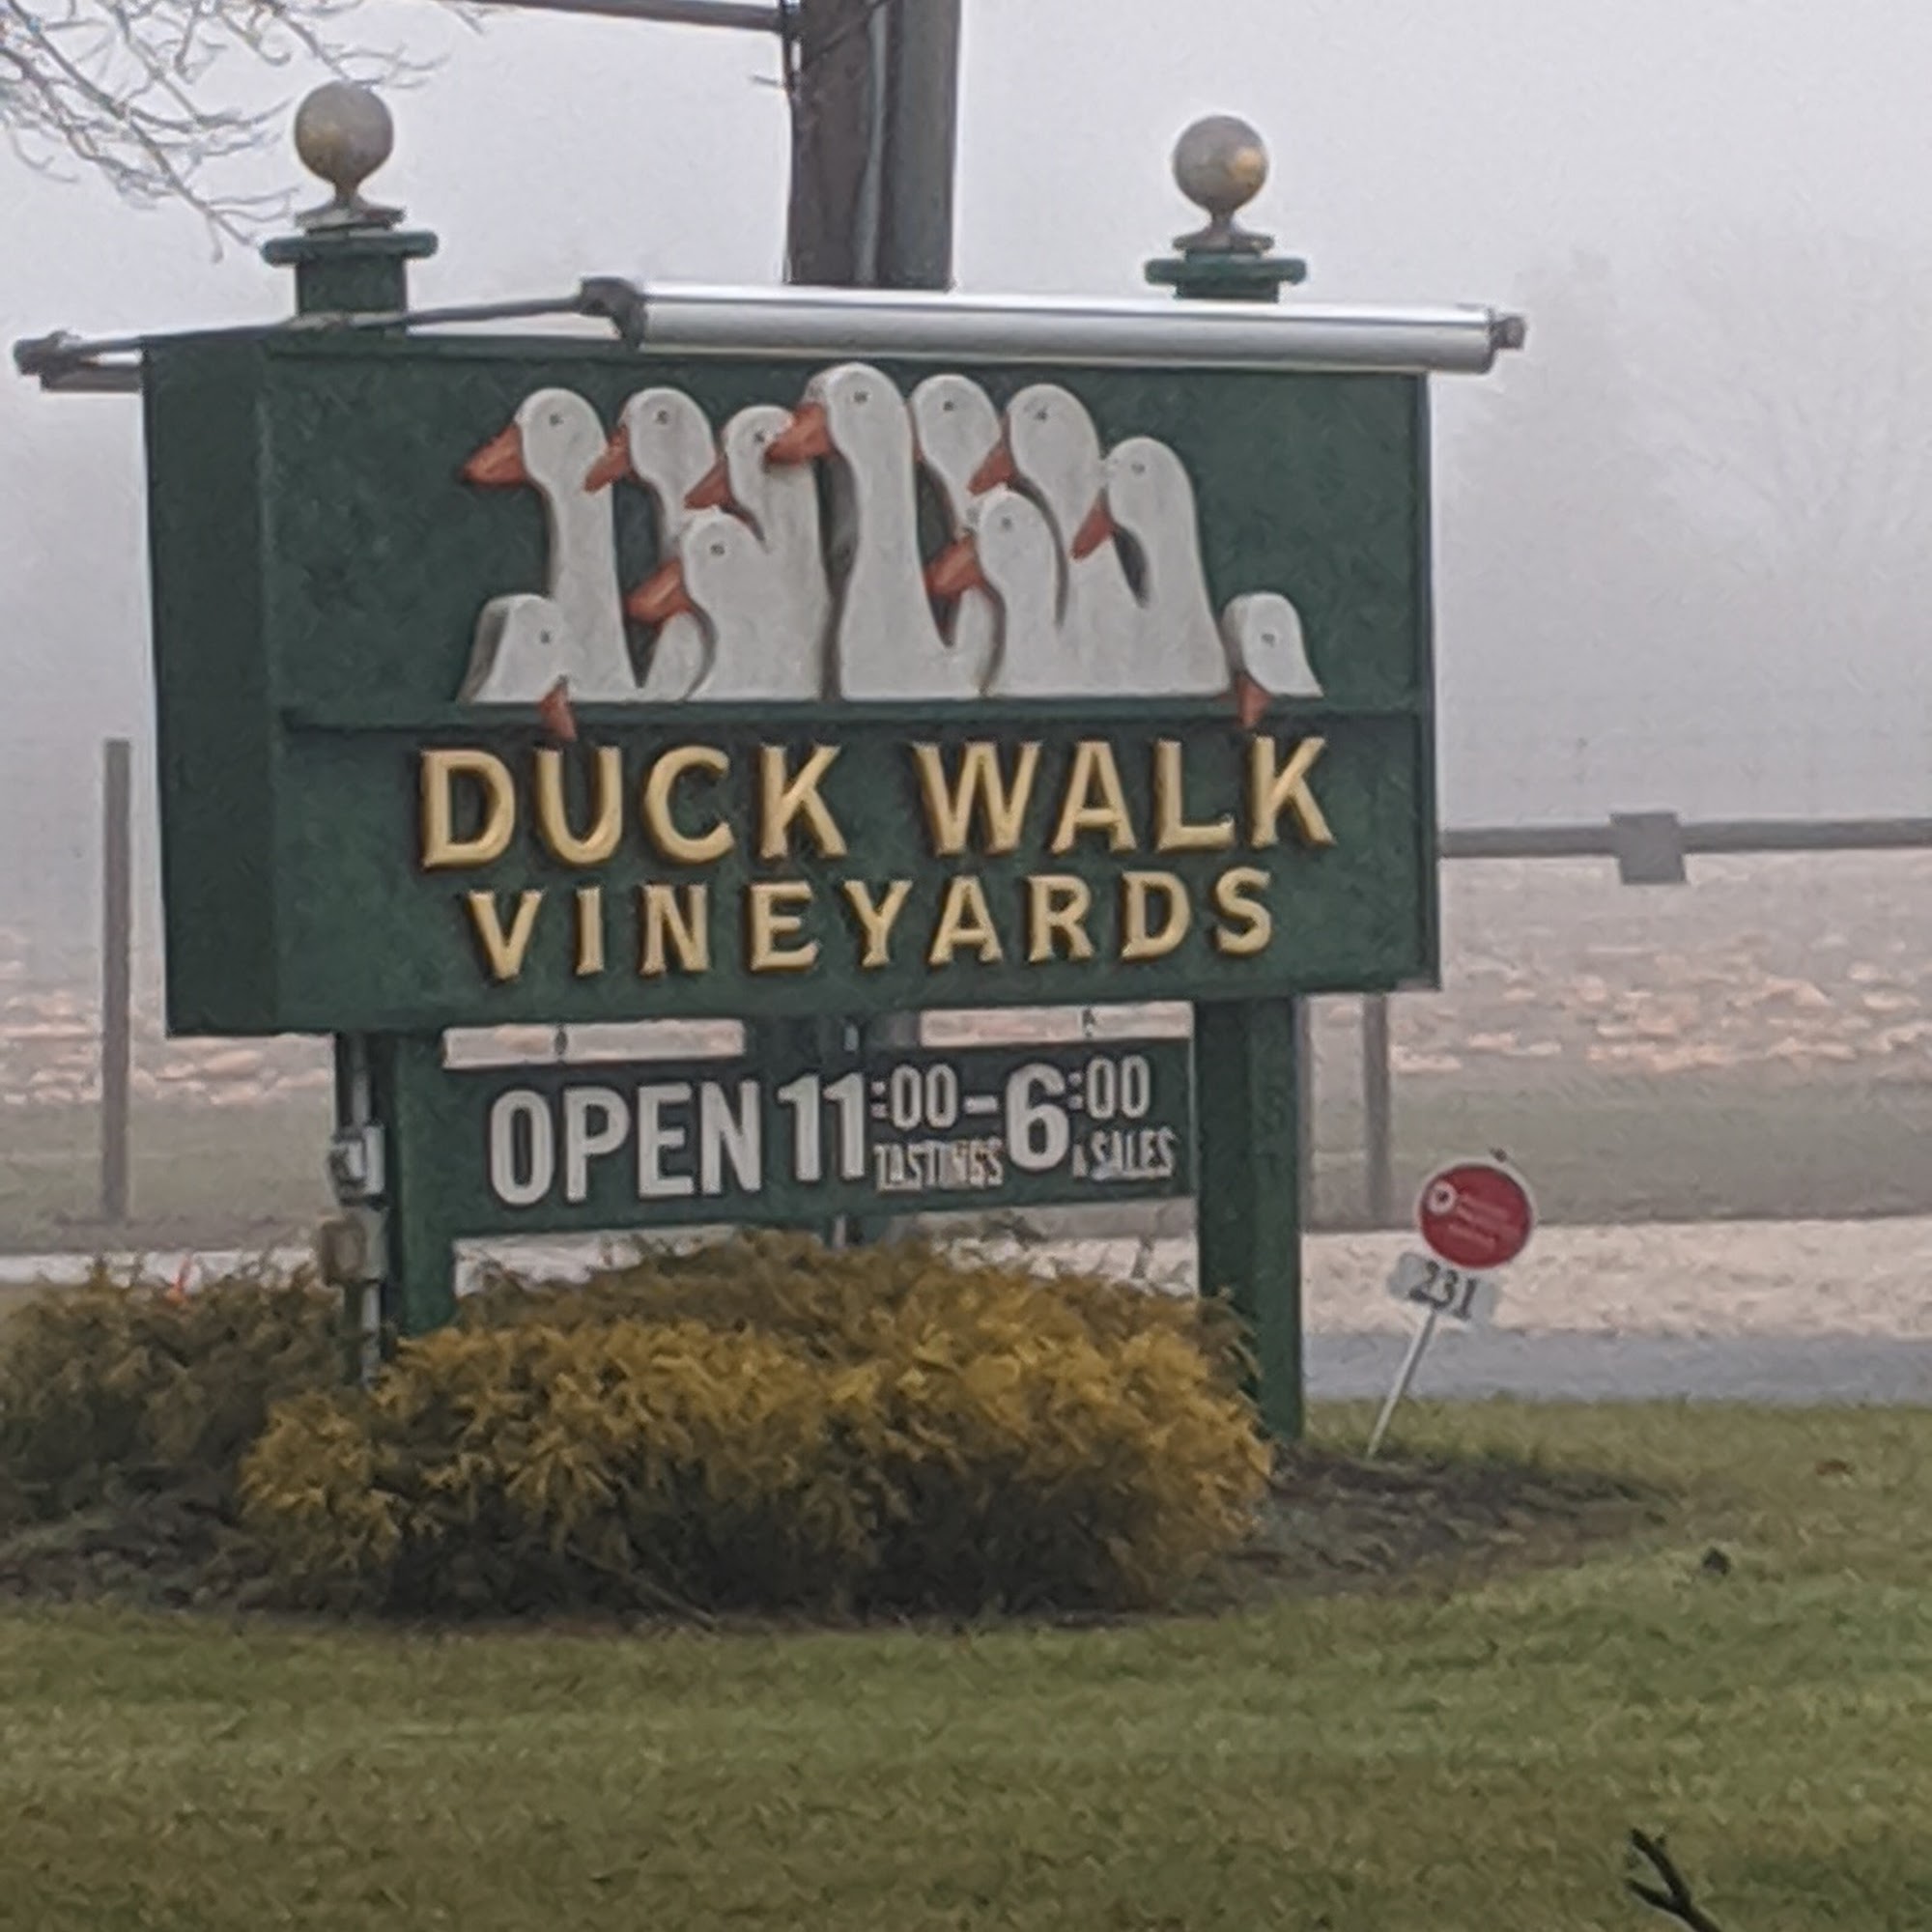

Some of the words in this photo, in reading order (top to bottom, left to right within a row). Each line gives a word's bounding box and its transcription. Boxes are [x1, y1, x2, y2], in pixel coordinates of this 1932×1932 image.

[420, 743, 847, 868] DUCK
[911, 734, 1336, 858] WALK
[467, 866, 1272, 982] VINEYARDS
[489, 1079, 763, 1208] OPEN
[1090, 1125, 1178, 1181] SALES
[1407, 1259, 1478, 1322] 231
